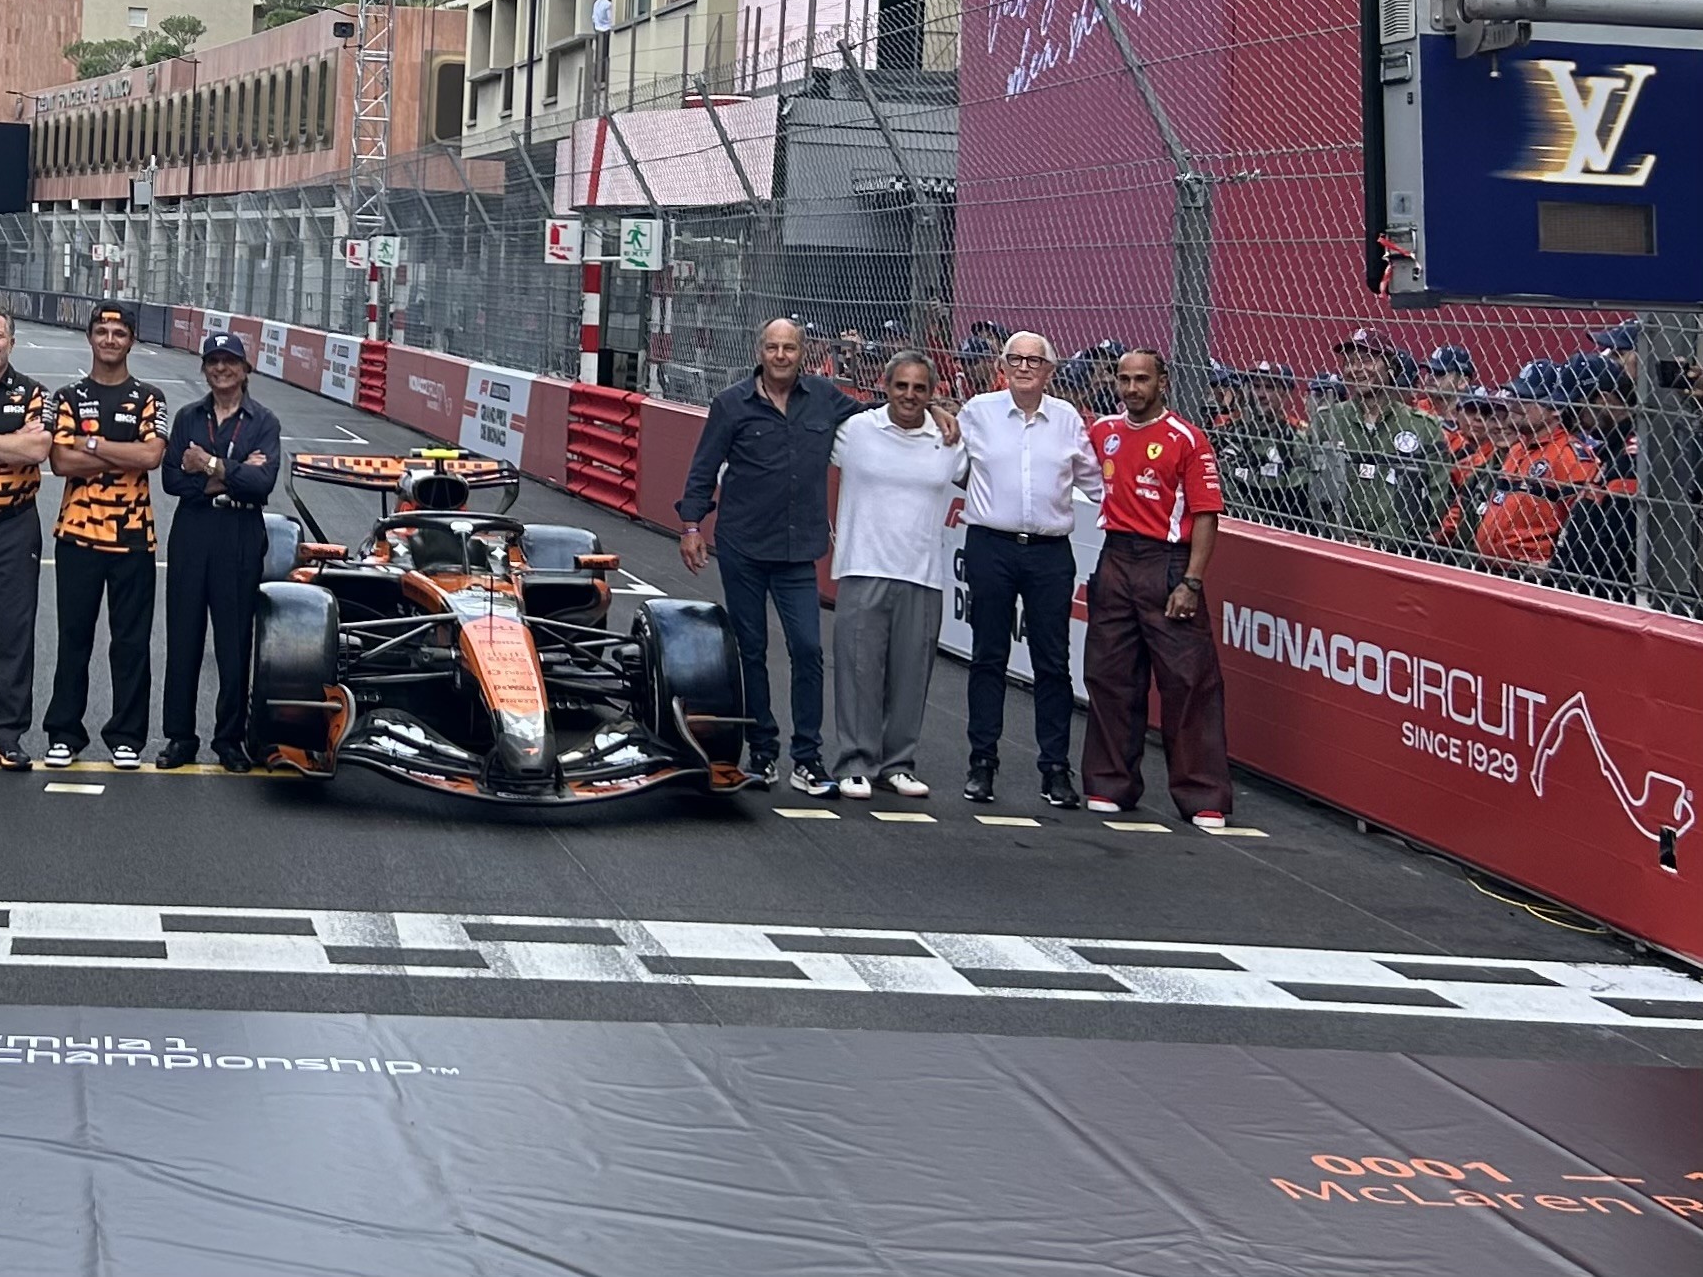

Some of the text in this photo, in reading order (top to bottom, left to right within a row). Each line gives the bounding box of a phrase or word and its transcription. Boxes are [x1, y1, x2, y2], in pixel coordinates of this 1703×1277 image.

[1401, 721, 1518, 783] SINCE 1929
[165, 1036, 198, 1053] 1
[1311, 1153, 1513, 1183] 0001
[1270, 1176, 1645, 1216] McLaren
